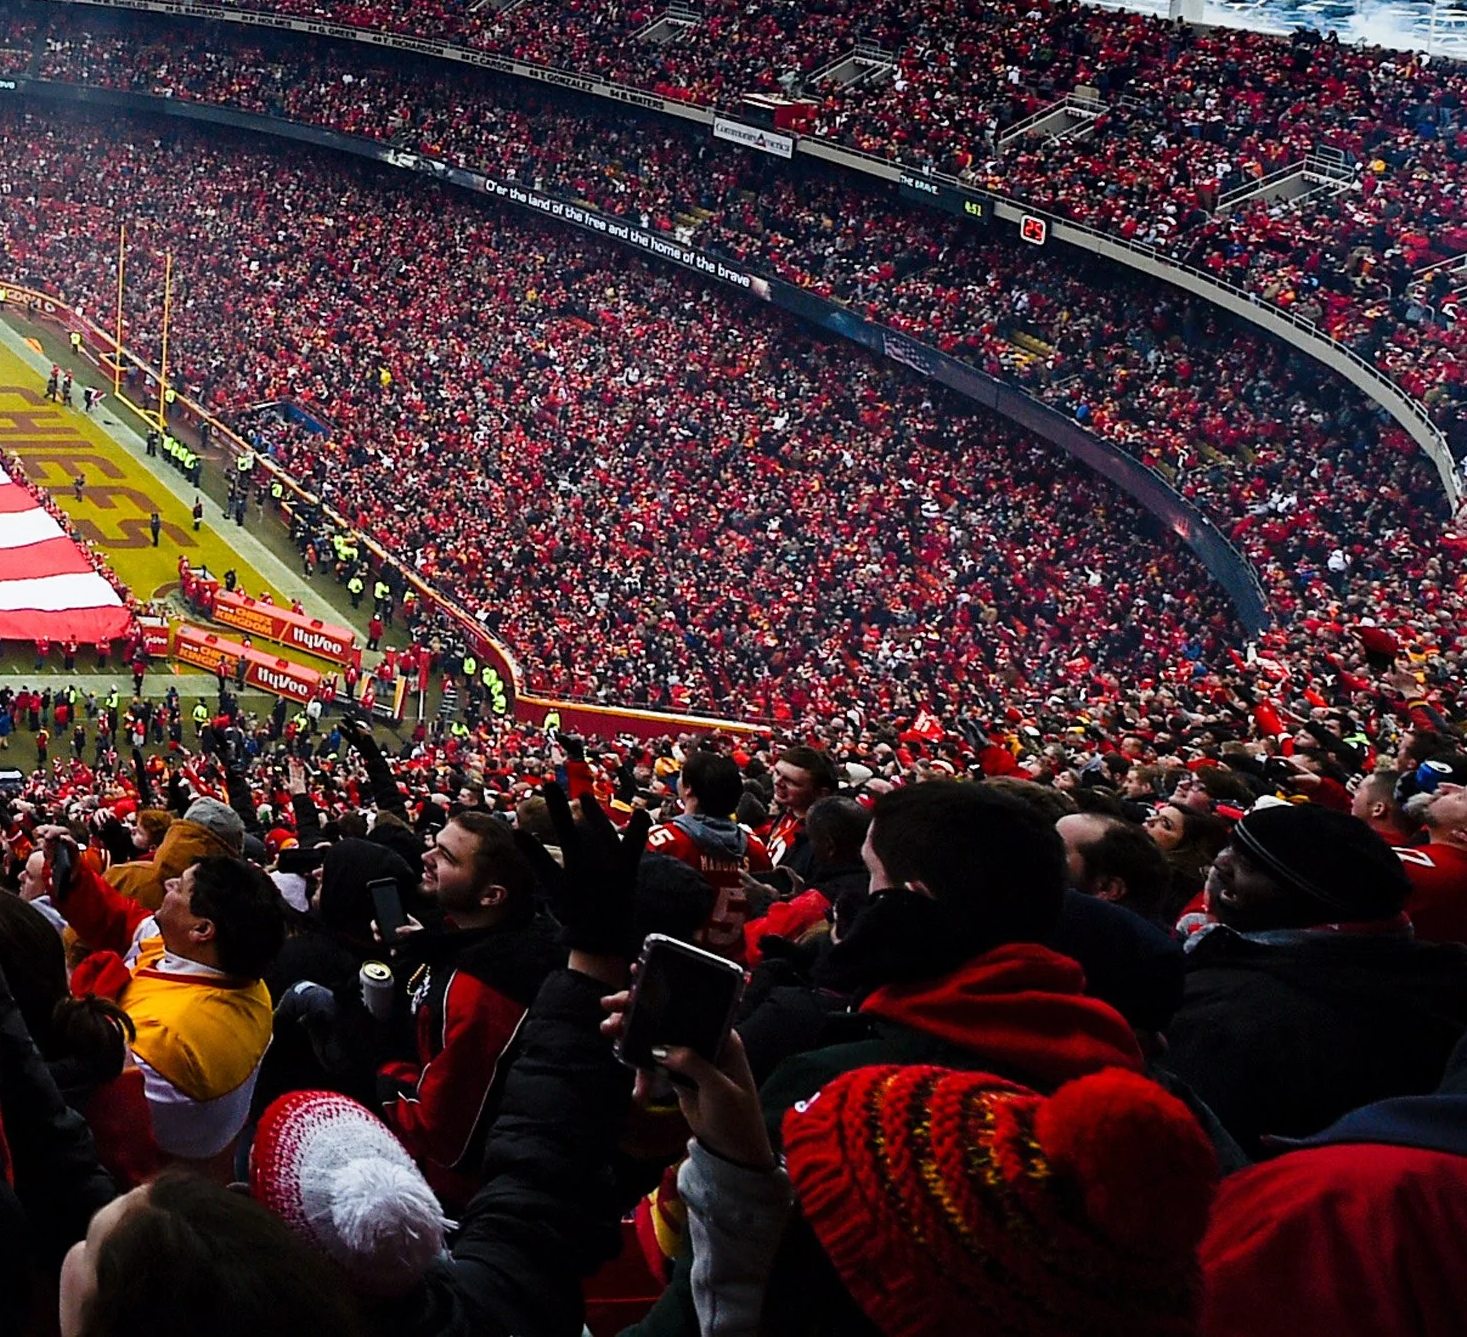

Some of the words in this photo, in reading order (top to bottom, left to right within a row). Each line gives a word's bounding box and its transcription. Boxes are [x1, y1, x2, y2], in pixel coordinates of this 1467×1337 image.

[486, 179, 508, 195] O'er
[510, 188, 527, 202] the
[528, 193, 551, 210] land
[552, 204, 564, 214] of
[565, 207, 583, 222] the
[585, 213, 607, 230] free
[608, 224, 629, 239] and
[630, 231, 649, 246] the
[650, 237, 681, 259] home
[682, 252, 695, 264] of
[696, 256, 716, 273] the
[717, 263, 751, 287] brave
[215, 610, 273, 636] KINGDOM
[293, 625, 343, 657] HyVee
[257, 666, 309, 698] HyVee
